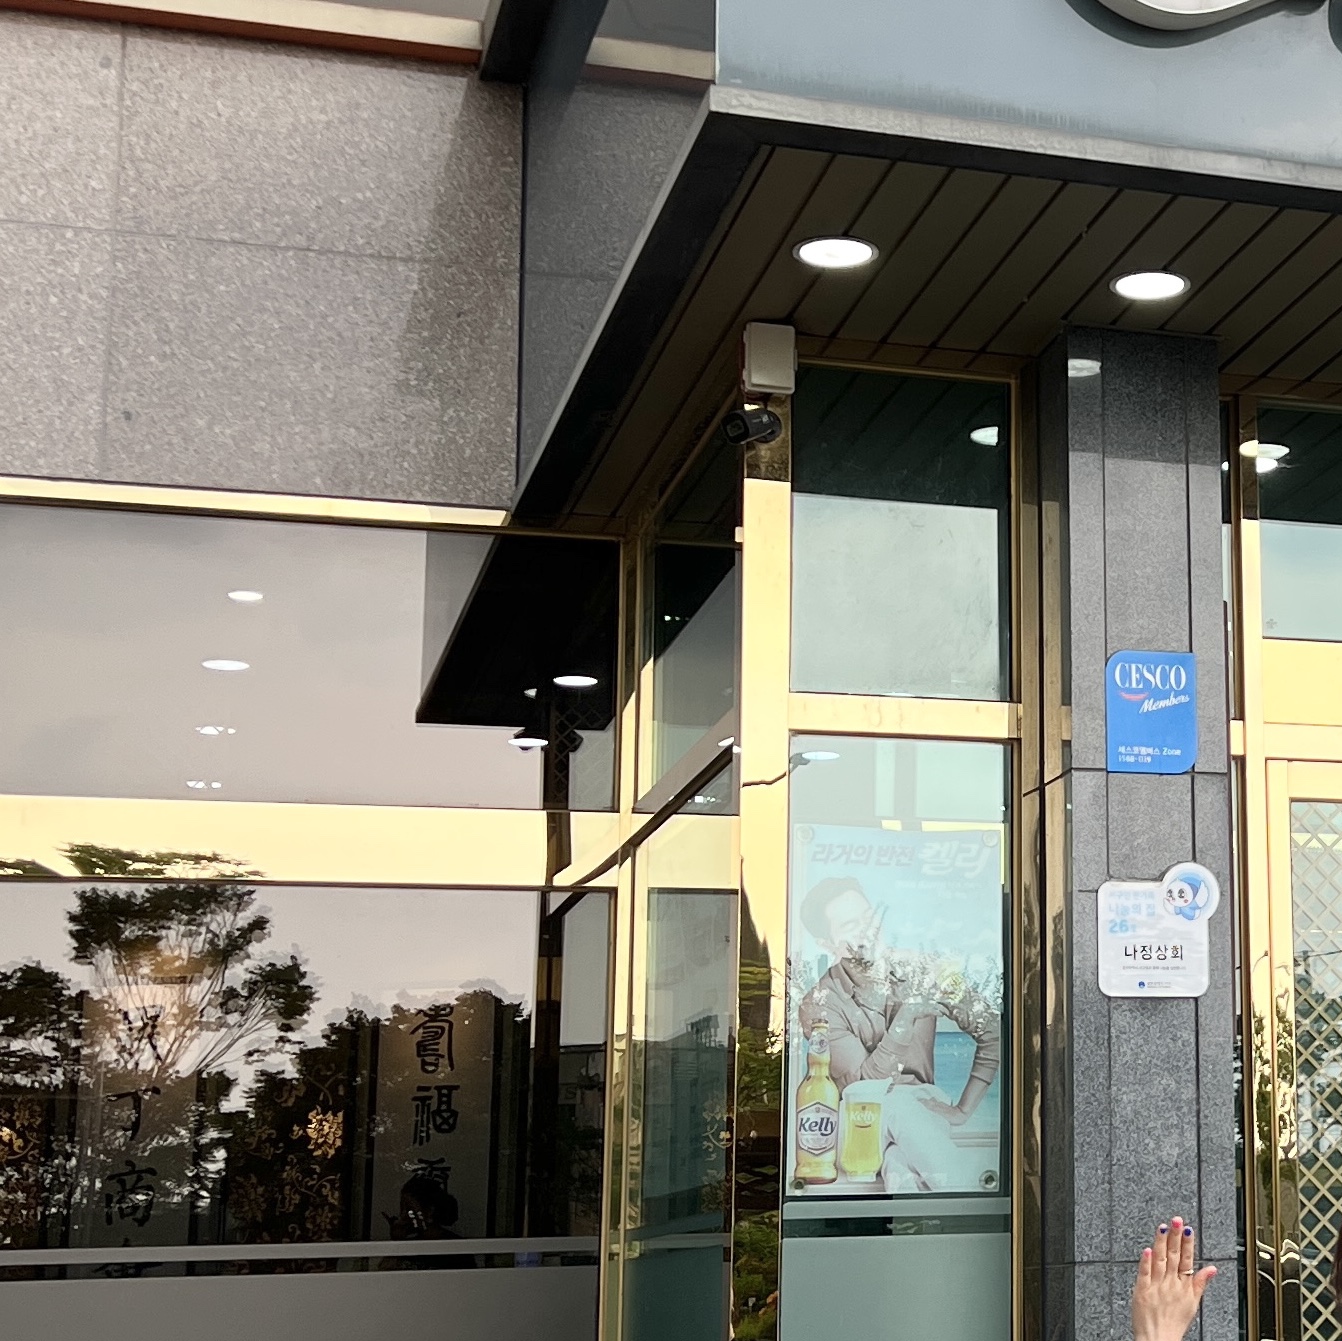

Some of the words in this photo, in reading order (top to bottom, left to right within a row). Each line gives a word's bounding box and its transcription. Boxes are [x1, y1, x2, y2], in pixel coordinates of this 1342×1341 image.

[1114, 662, 1187, 691] CESCO
[1139, 691, 1190, 714] Members
[1162, 747, 1182, 756] Zone
[811, 843, 873, 865] 라거의
[874, 844, 916, 867] 반전
[918, 840, 992, 879] 켈리
[1123, 943, 1184, 961] 나정상회
[798, 1116, 837, 1137] Kelly
